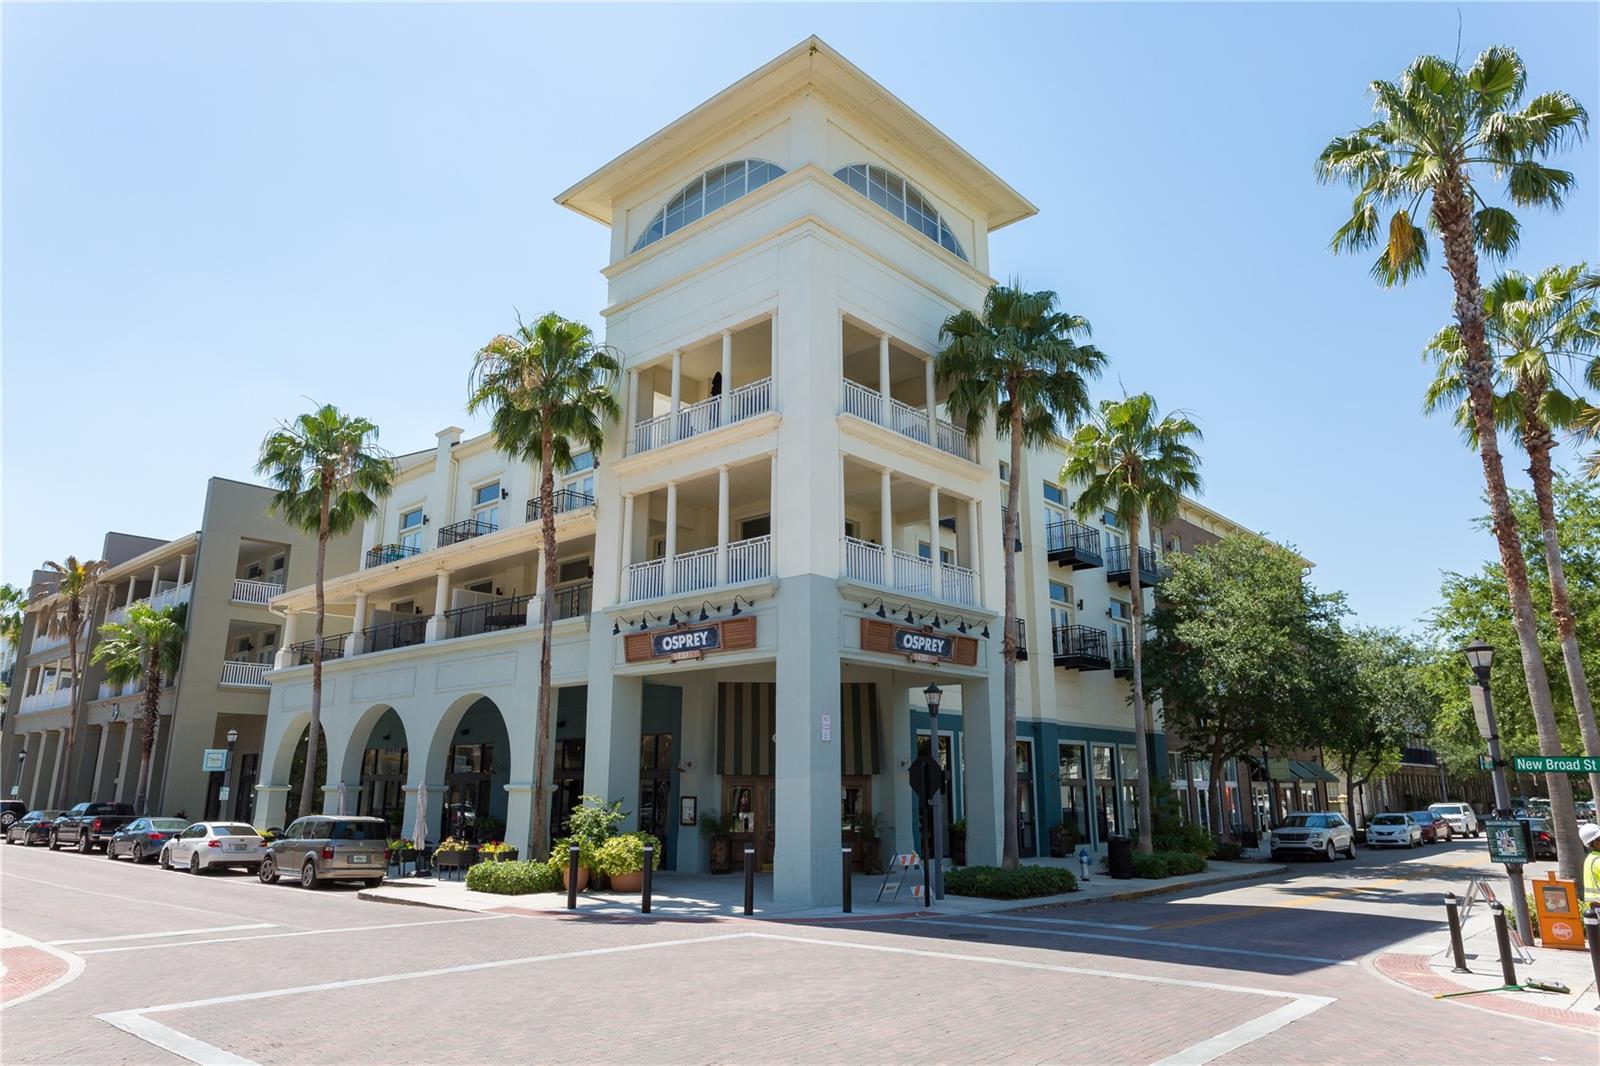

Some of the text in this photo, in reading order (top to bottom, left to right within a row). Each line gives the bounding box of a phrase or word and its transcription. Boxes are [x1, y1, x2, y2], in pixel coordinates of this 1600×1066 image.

[662, 631, 708, 650] OSPREY
[903, 634, 944, 653] OSPREY
[1517, 759, 1597, 771] New Broad St
